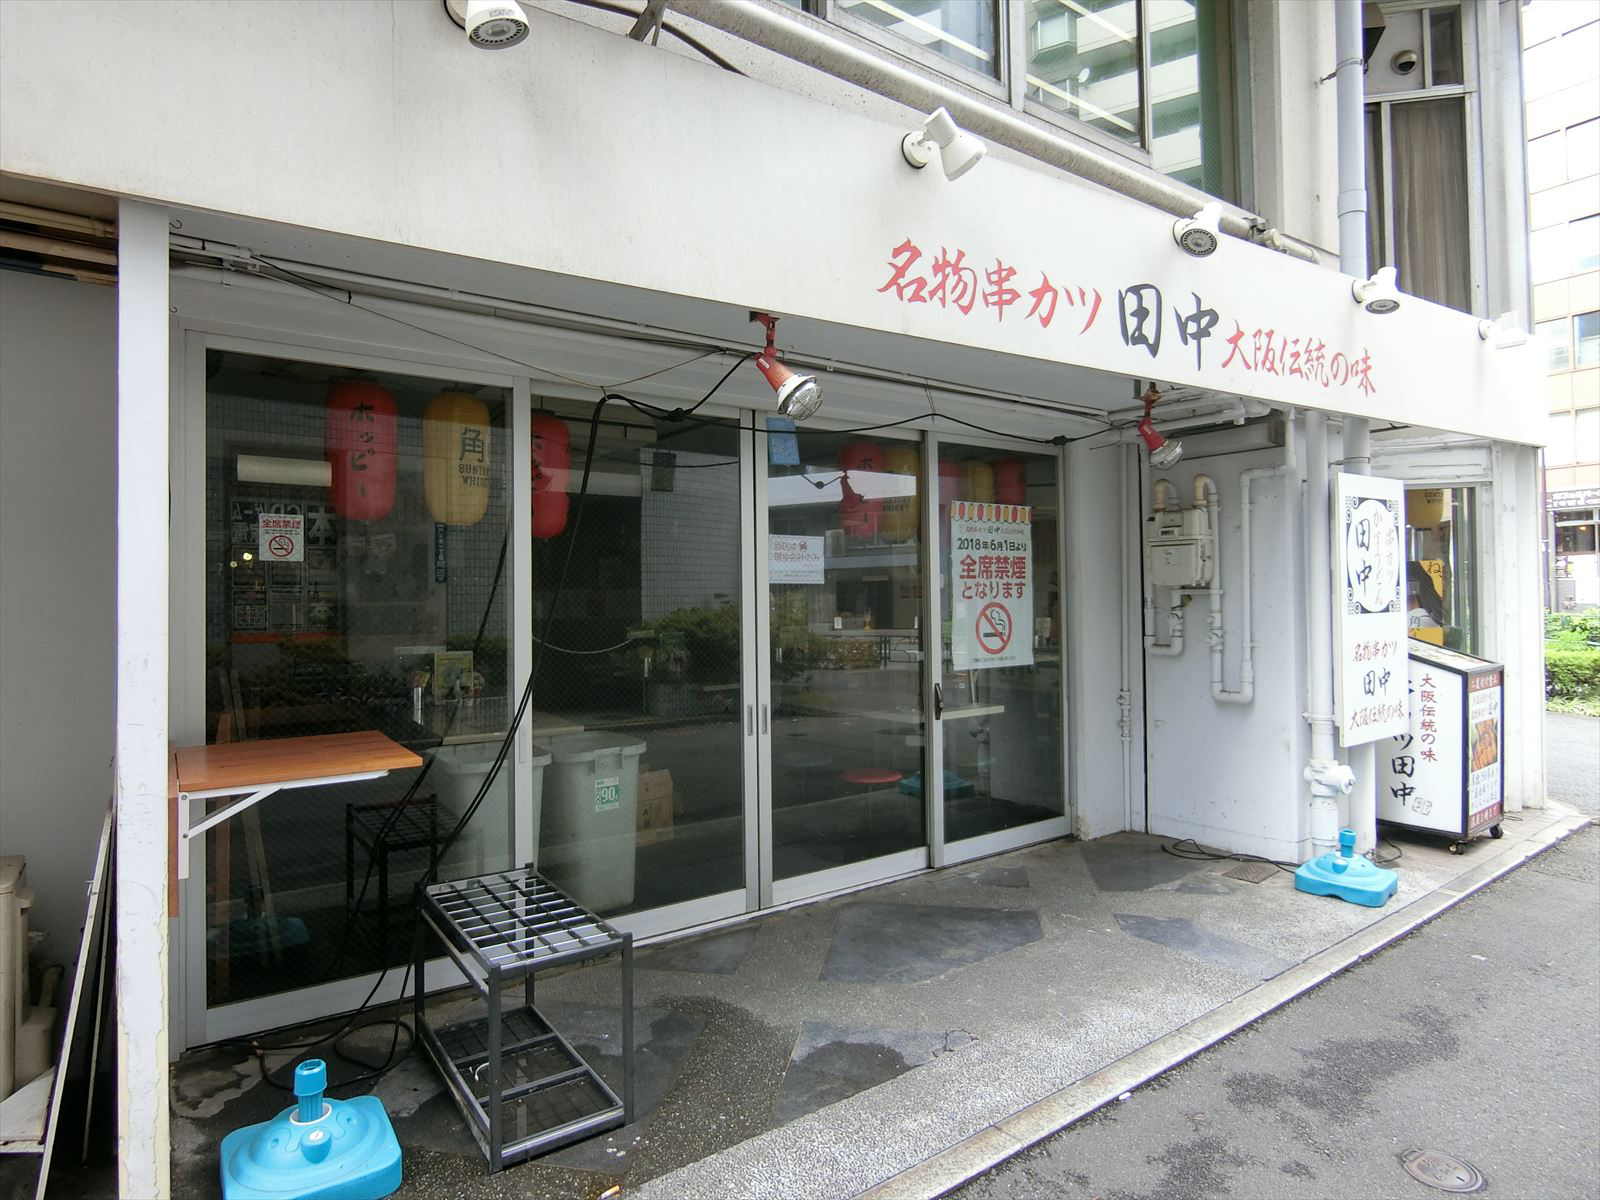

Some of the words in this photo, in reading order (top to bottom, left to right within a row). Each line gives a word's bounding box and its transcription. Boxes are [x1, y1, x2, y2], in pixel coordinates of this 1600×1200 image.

[876, 237, 1102, 336] 名物串カツ
[1118, 283, 1220, 371] 田中
[1221, 319, 1376, 397] 大阪伝統の味
[459, 427, 485, 464] 角
[956, 538, 1027, 552] 2018年6月1日より
[1355, 518, 1373, 596] 田中
[959, 554, 1026, 580] 全席禁煙
[960, 581, 1026, 600] となります
[1353, 640, 1397, 663] 名物串カツ
[1364, 666, 1391, 697] 田中
[1349, 697, 1405, 731] 大阪伝統の味
[1419, 673, 1437, 763] 大阪伝統の味
